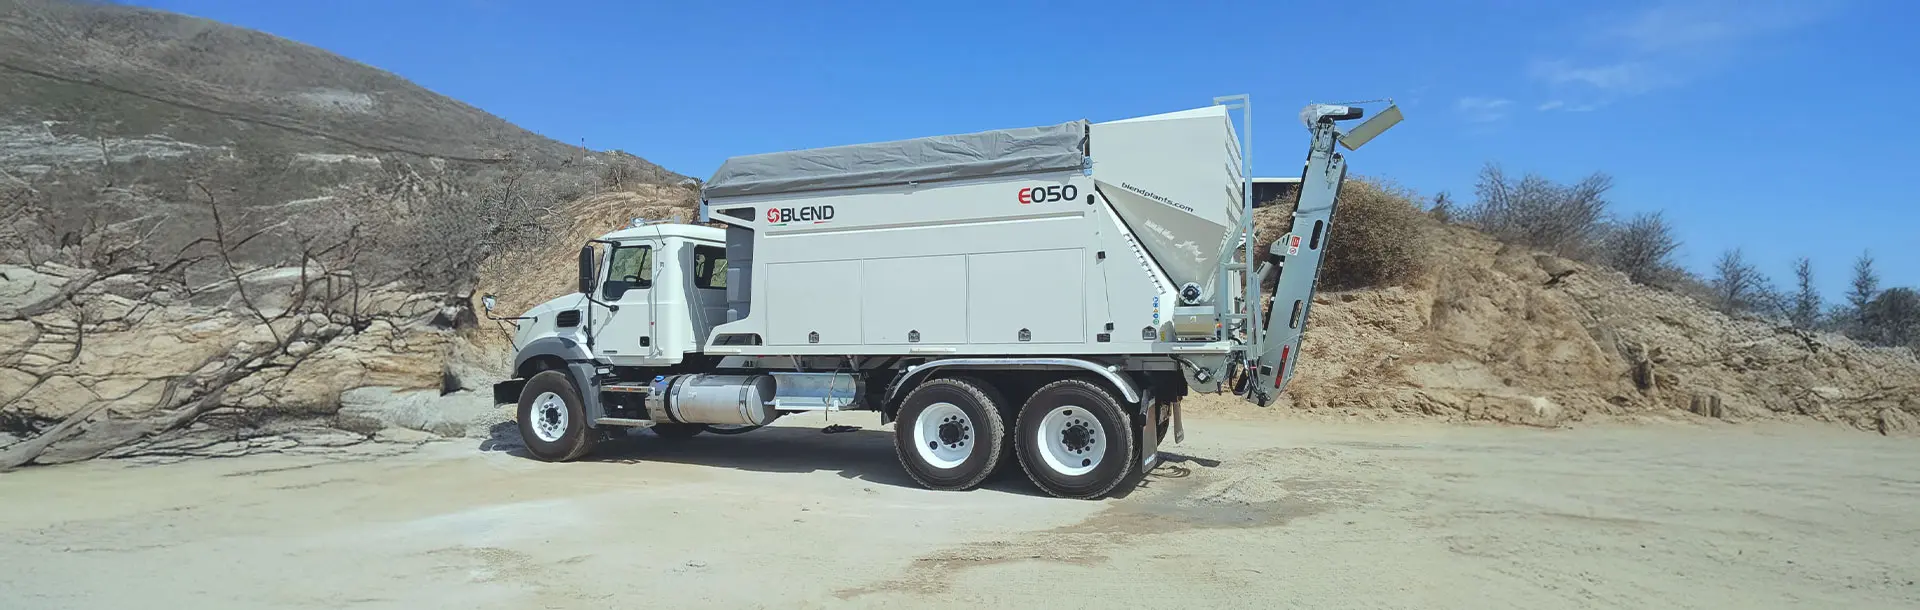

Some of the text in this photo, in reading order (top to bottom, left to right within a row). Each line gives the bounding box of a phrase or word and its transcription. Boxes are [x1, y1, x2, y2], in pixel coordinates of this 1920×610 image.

[1018, 184, 1078, 204] E050
[1121, 182, 1194, 213] blendplants.com
[780, 205, 835, 222] BLEND
